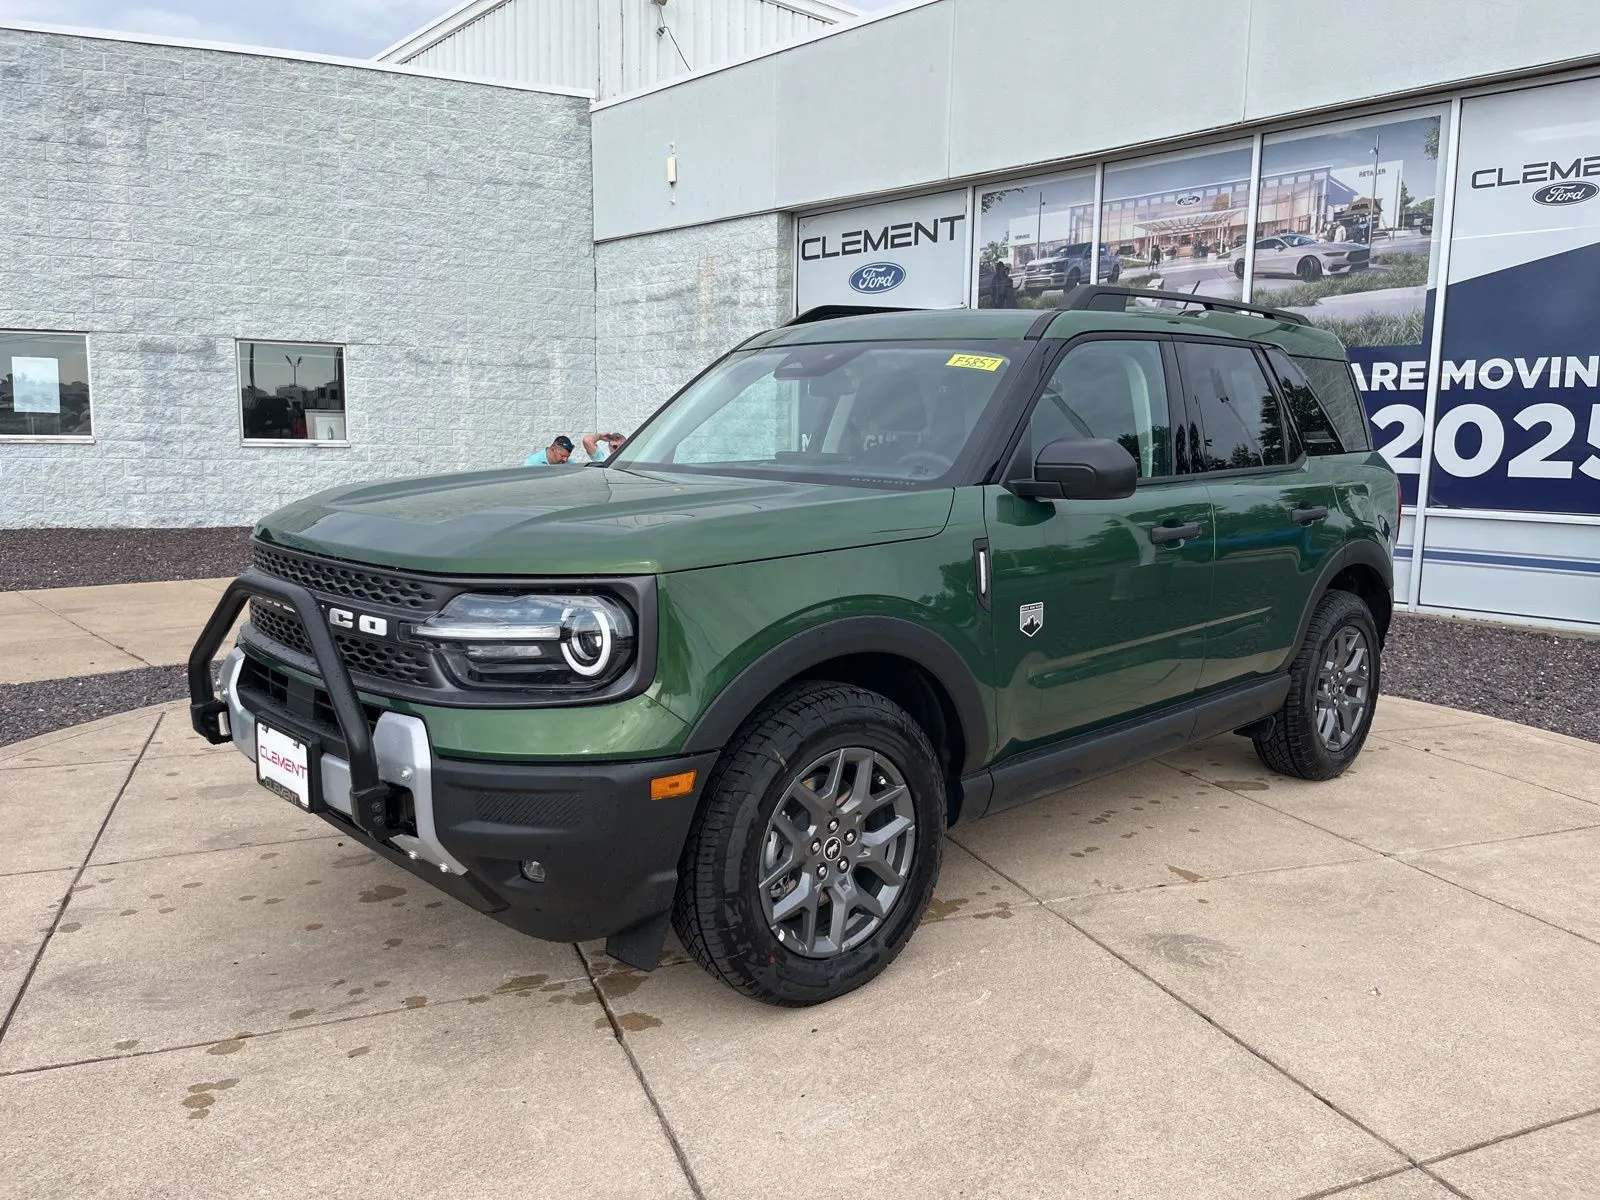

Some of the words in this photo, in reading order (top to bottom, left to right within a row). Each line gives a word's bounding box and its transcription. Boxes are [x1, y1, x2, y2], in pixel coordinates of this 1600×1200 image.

[1545, 185, 1586, 202] Ford
[801, 214, 965, 261] CLEMENT
[859, 267, 896, 289] Ford
[953, 356, 999, 369] F5857
[260, 745, 308, 779] CLEMENT
